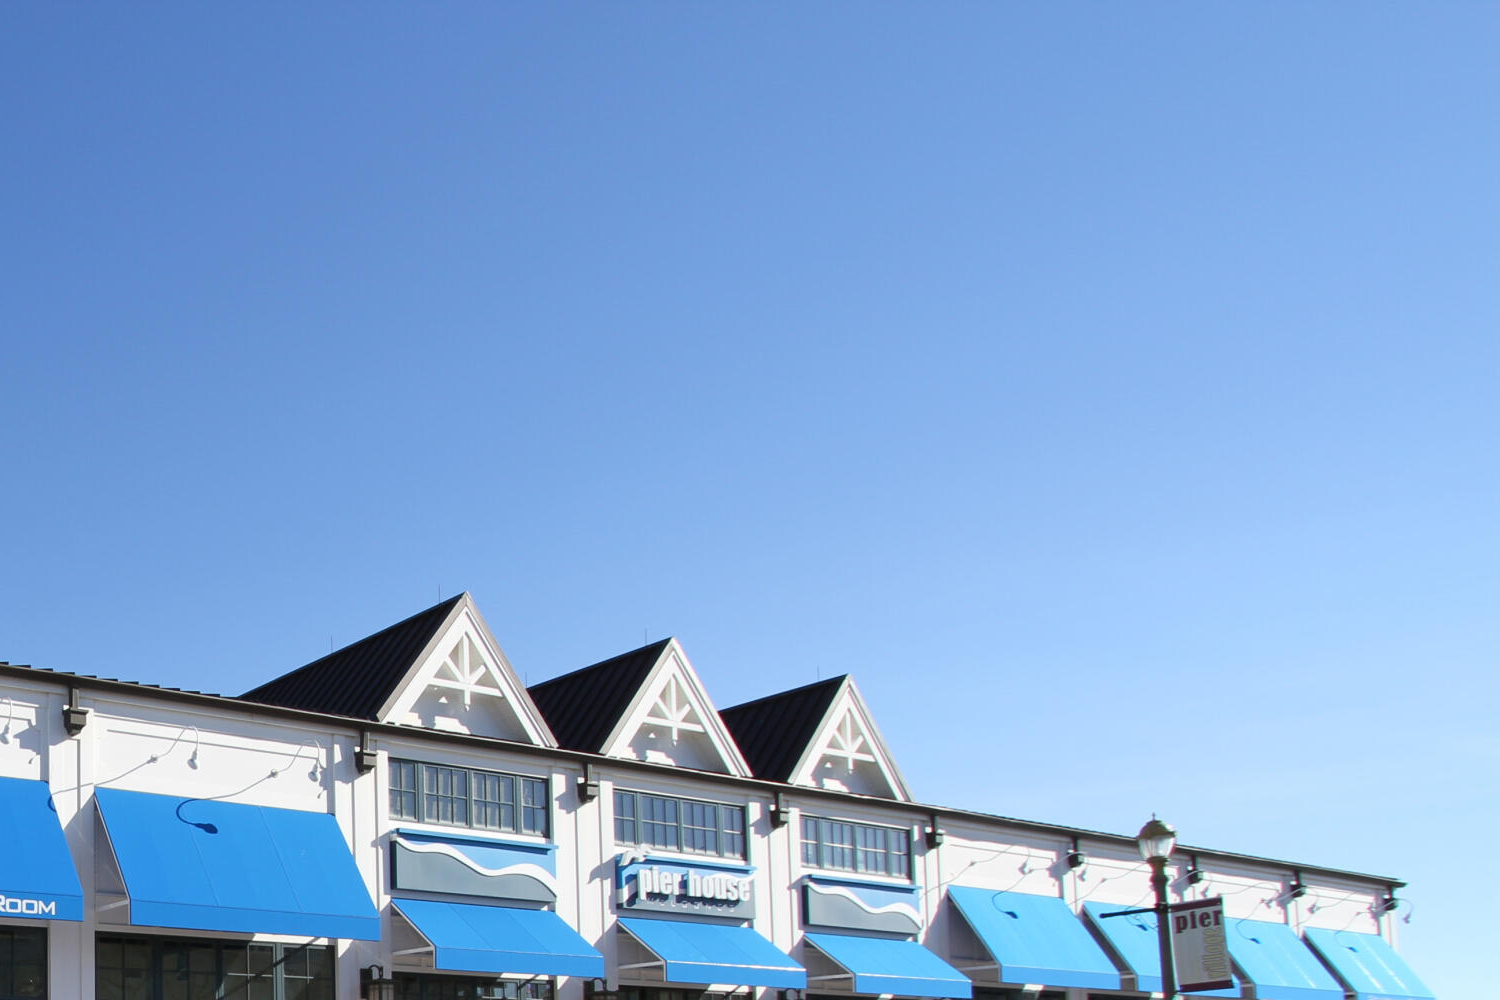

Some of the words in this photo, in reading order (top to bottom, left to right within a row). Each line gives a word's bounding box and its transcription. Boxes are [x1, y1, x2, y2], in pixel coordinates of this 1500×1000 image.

[637, 865, 684, 900] pier
[687, 869, 750, 901] house
[1175, 910, 1222, 934] pier
